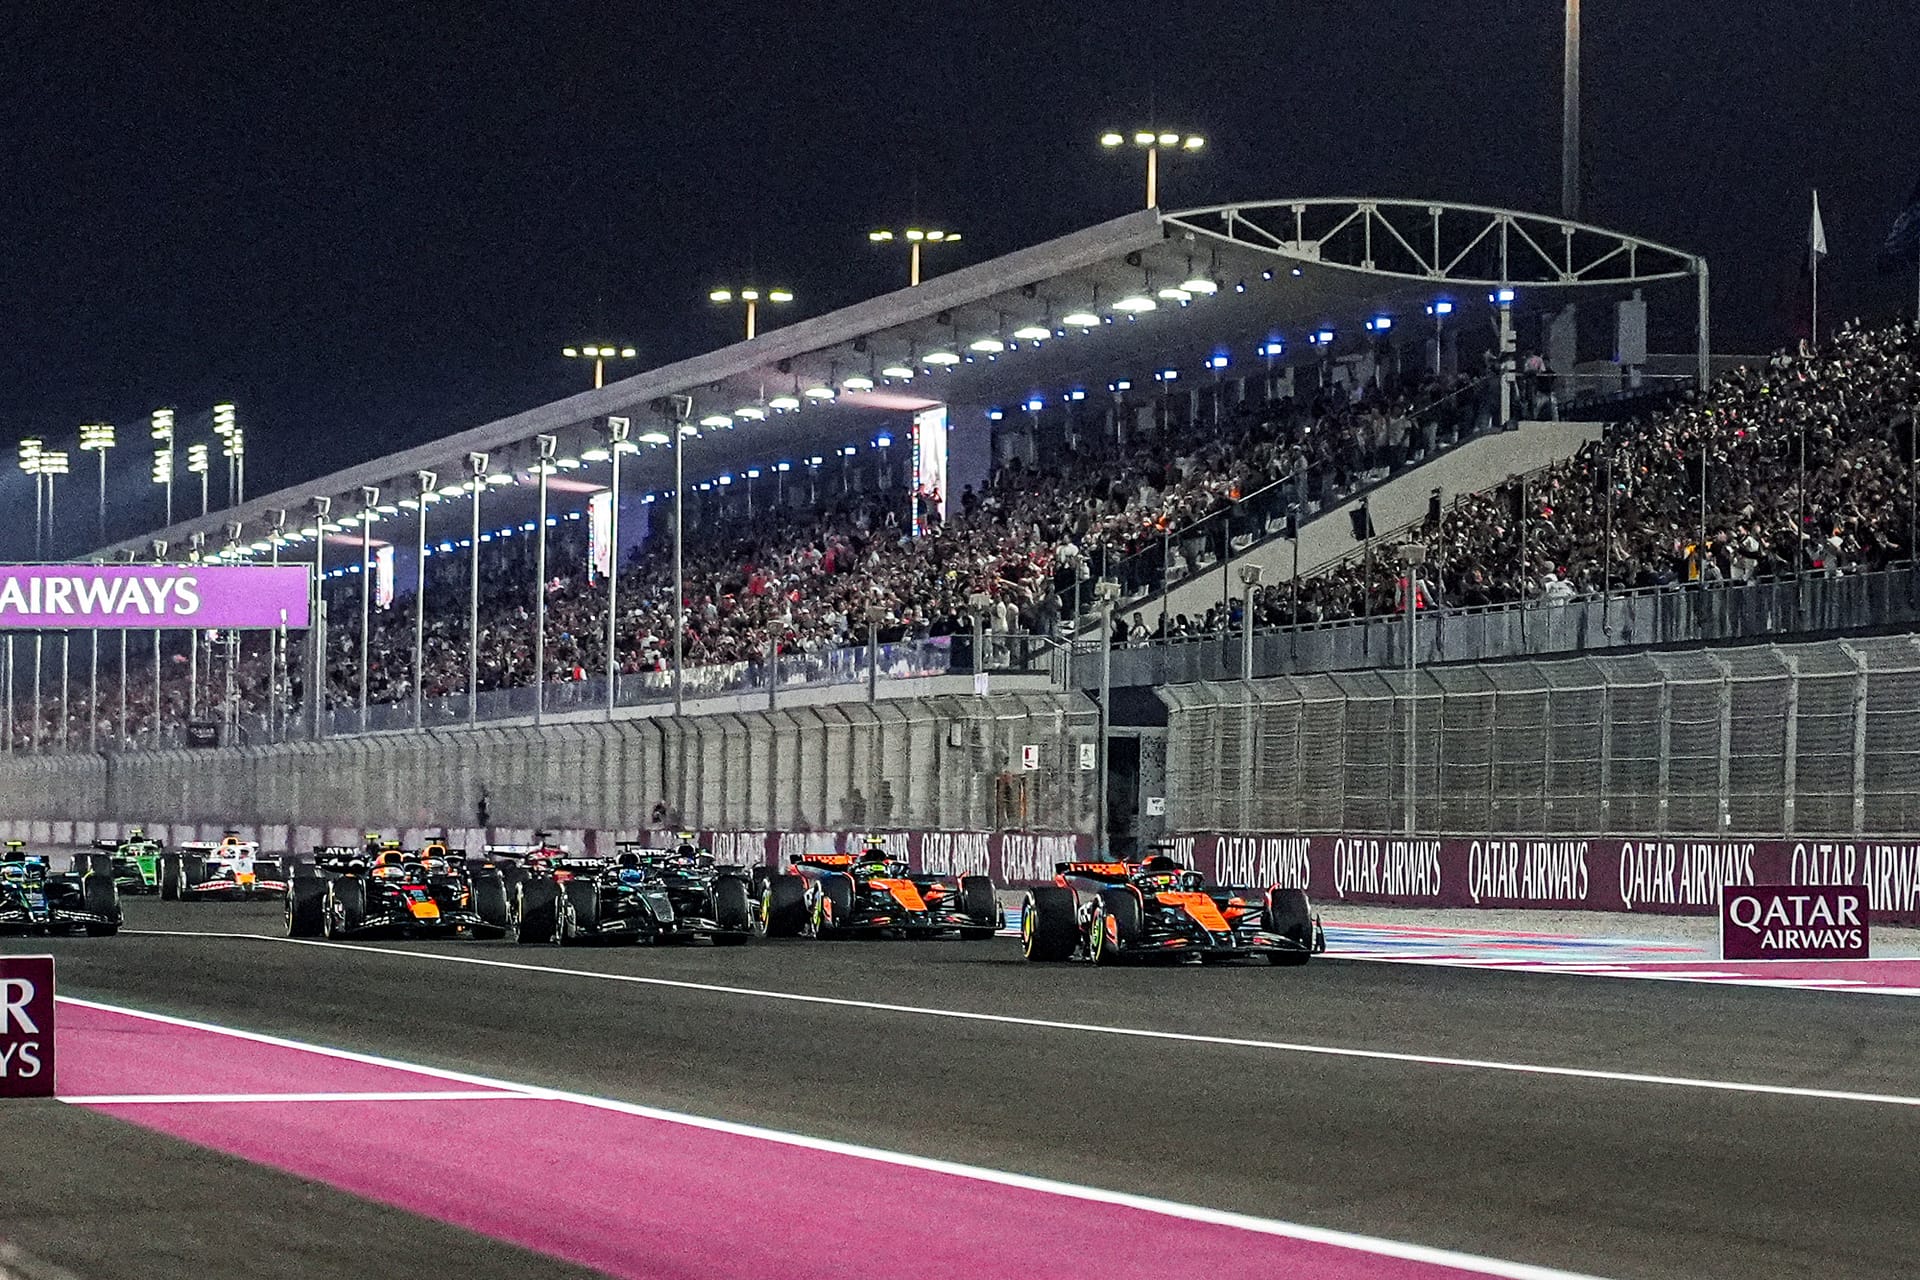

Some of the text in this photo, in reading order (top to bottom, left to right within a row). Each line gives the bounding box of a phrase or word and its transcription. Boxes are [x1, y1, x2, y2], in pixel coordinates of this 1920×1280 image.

[0, 577, 200, 614] AIRWAYS
[1215, 836, 1310, 890] QATAR AIRWAYS
[1334, 838, 1441, 898] QATAR AIRWAYS
[1468, 840, 1588, 904] QATAR AIRWAYS
[1619, 842, 1755, 910] QATAR AIRWAYS
[1791, 843, 1856, 886] QATAR
[1730, 895, 1861, 934] QATAR
[1761, 929, 1862, 949] AIRWAYS
